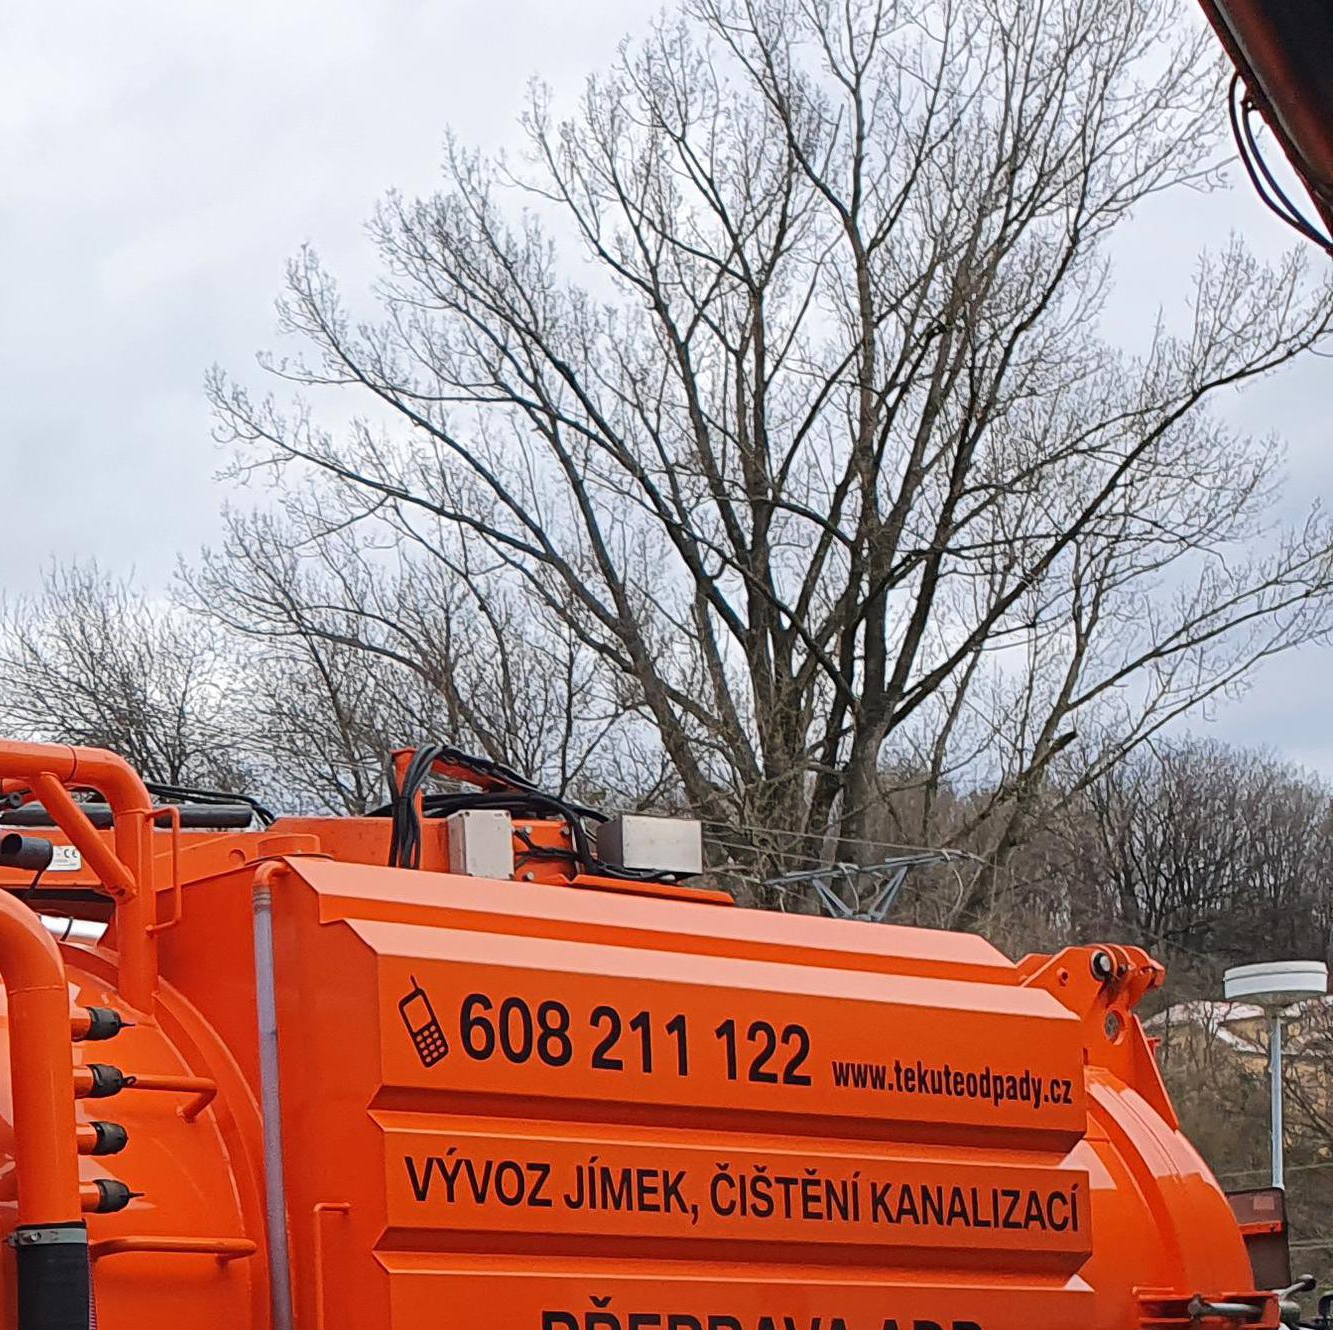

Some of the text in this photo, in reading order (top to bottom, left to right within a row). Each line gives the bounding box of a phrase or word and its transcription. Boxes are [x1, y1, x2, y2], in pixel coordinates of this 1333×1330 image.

[460, 993, 813, 1087] 608 211 122
[833, 1060, 1073, 1109] www.tekuteodpady.cz
[404, 1147, 1079, 1233] VÝVOZ JÍMEK, ČIŠTĚNÍ KANALIZACÍ
